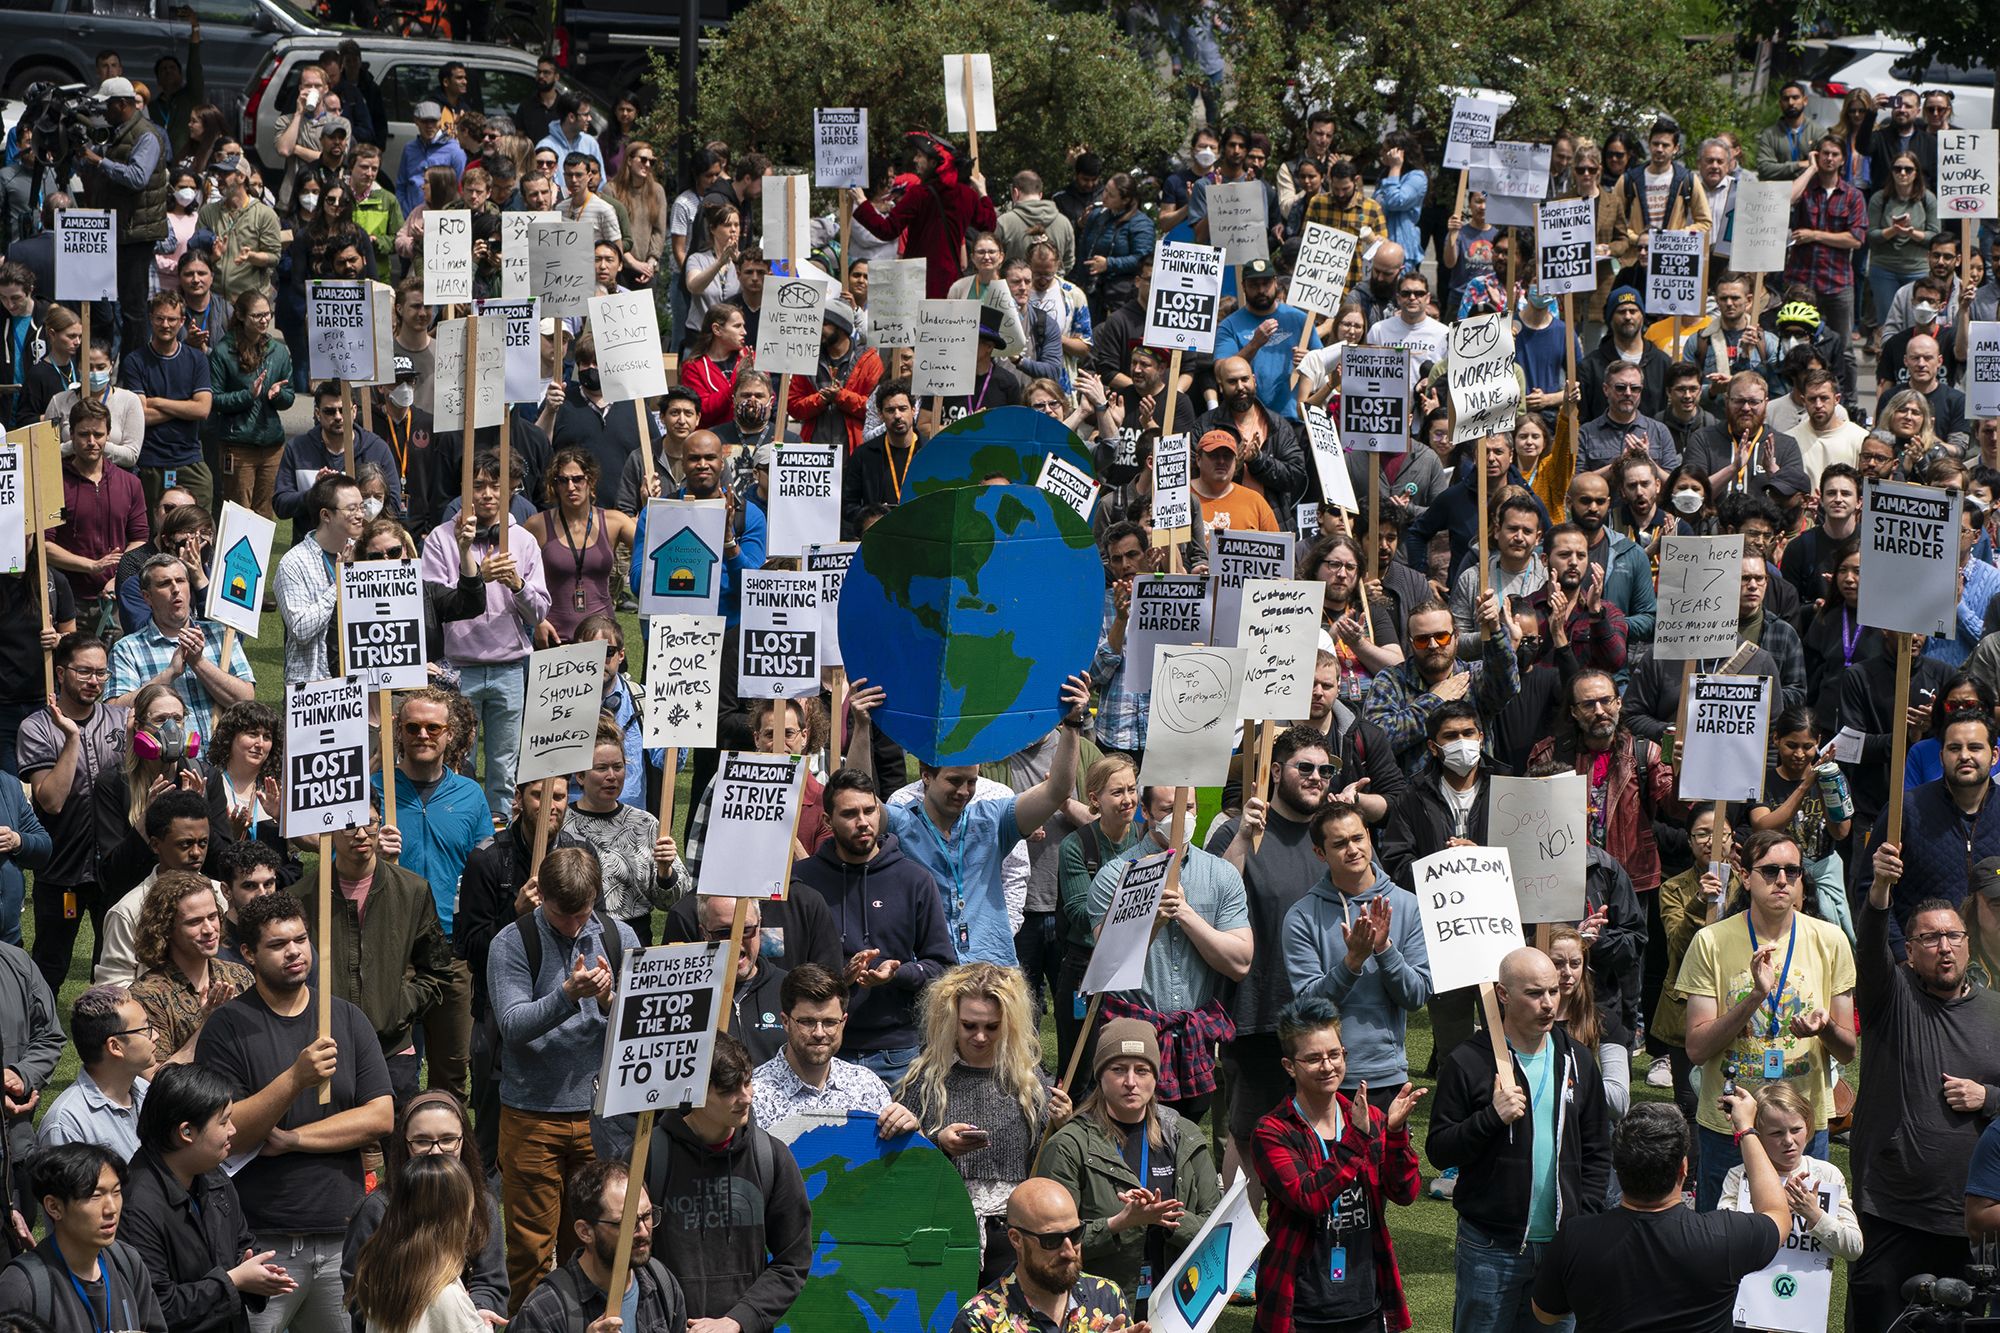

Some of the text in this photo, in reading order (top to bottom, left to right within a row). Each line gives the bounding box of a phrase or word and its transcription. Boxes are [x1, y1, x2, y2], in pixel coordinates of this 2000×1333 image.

[821, 126, 857, 135] STRIVE
[821, 137, 858, 145] HARDER
[1944, 135, 1980, 150] LET
[1942, 154, 1966, 165] ME
[1942, 169, 1984, 181] WORK
[1758, 192, 1775, 200] THE
[1941, 183, 1991, 196] BETTER
[1541, 205, 1590, 218] SHORT-TERM
[1745, 203, 1778, 212] FUTURE
[64, 218, 107, 228] AMAZON:
[439, 217, 466, 235] RTO
[1541, 216, 1591, 230] THINKING
[1745, 227, 1777, 235] CLIMATE
[64, 232, 108, 243] STRIVE
[538, 229, 577, 247] RTO
[64, 242, 108, 254] HARDER
[1547, 243, 1586, 262] LOST
[1654, 243, 1698, 251] EMPLOYER?
[1161, 248, 1220, 263] SHORT-TERM
[1300, 246, 1349, 270] PLEDGES
[1661, 255, 1690, 266] STOP
[1160, 259, 1218, 275] THINKING
[1544, 258, 1590, 277] TRUST
[1660, 265, 1690, 275] THE PR
[435, 280, 468, 296] HARM
[1653, 279, 1694, 289] & LISTEN
[317, 289, 362, 299] AMAZON:
[1162, 291, 1208, 312] LOST
[1296, 281, 1339, 313] TRUST
[1653, 288, 1695, 301] TO US
[316, 303, 363, 315] STRIVE
[601, 302, 639, 323] RTO
[317, 317, 363, 327] HARDER
[768, 312, 820, 323] WE WORK
[920, 310, 977, 328] Undercounting
[1156, 308, 1210, 331] TRUST
[603, 326, 647, 344] IS NOT
[780, 326, 818, 335] BETTER
[920, 332, 965, 343] Emissions
[318, 341, 364, 353] EARTH
[762, 342, 820, 358] AT HOME
[1384, 340, 1435, 351] unionize
[342, 363, 357, 373] US
[604, 359, 651, 377] Accessible
[920, 360, 956, 372] Climate
[1346, 354, 1404, 366] SHORT-TERM
[1347, 365, 1403, 379] THINKING
[1351, 398, 1396, 415] LOST
[1465, 387, 1502, 413] MAKE
[1347, 413, 1400, 433] TRUST
[781, 451, 832, 466] AMAZON:
[780, 470, 831, 484] STRIVE
[1050, 468, 1089, 498] AMAZON:
[780, 485, 831, 497] HARDER
[1044, 480, 1084, 512] STRIVE
[1157, 503, 1186, 516] LOWERING
[1877, 496, 1945, 518] AMAZON:
[1160, 515, 1185, 527] THE BAR
[1874, 517, 1944, 542] STRIVE
[1223, 541, 1281, 557] AMAZON:
[1666, 543, 1738, 563] Been here
[1874, 535, 1944, 559] HARDER
[345, 568, 416, 582] SHORT-TERM
[1221, 558, 1281, 577] STRIVE
[346, 582, 418, 598] THINKING
[746, 579, 816, 591] SHORT-TERM
[1142, 582, 1202, 597] AMAZON:
[746, 592, 816, 608] THINKING
[1670, 596, 1722, 615] YEARS
[1140, 602, 1200, 618] STRIVE
[1139, 617, 1200, 632] HARDER
[1657, 619, 1738, 630] DOES AMAZON CARE
[356, 622, 410, 645] LOST
[751, 632, 807, 651] LOST
[1657, 635, 1685, 643] ABOUT
[352, 644, 417, 668] TRUST
[669, 654, 707, 672] OUR
[747, 653, 811, 675] TRUST
[539, 661, 598, 681] PLEDGES
[1245, 668, 1277, 682] NOT
[291, 685, 363, 708] SHORT-TERM
[540, 683, 593, 707] SHOULD
[654, 680, 712, 698] WINTERS
[1264, 682, 1291, 696] Fire
[1700, 687, 1757, 700] AMAZON:
[292, 701, 363, 728] THINKING
[1699, 704, 1756, 721] STRIVE
[1696, 719, 1755, 735] HARDER
[530, 730, 590, 750] HONORED
[300, 750, 355, 781] LOST
[729, 764, 791, 780] AMAZON:
[294, 776, 361, 806] TRUST
[724, 785, 787, 804] STRIVE
[722, 804, 784, 821] HARDER
[1497, 793, 1551, 837] Say
[1539, 824, 1575, 861] NO!
[1125, 864, 1163, 885] AMAZON:
[1523, 874, 1559, 899] RTO
[1118, 883, 1160, 908] STRIVE
[1433, 891, 1465, 909] DO
[1112, 901, 1152, 925] HARDER
[1437, 917, 1517, 942] BETTER
[684, 955, 715, 969] BEST
[630, 969, 713, 990] EMPLOYER?
[639, 994, 693, 1018] STOP
[636, 1015, 692, 1034] THE PR
[622, 1039, 698, 1062] & LISTEN
[618, 1057, 696, 1087] TO US
[692, 1176, 728, 1194] THE
[664, 1196, 728, 1212] NORTH
[684, 1211, 731, 1230] FACE
